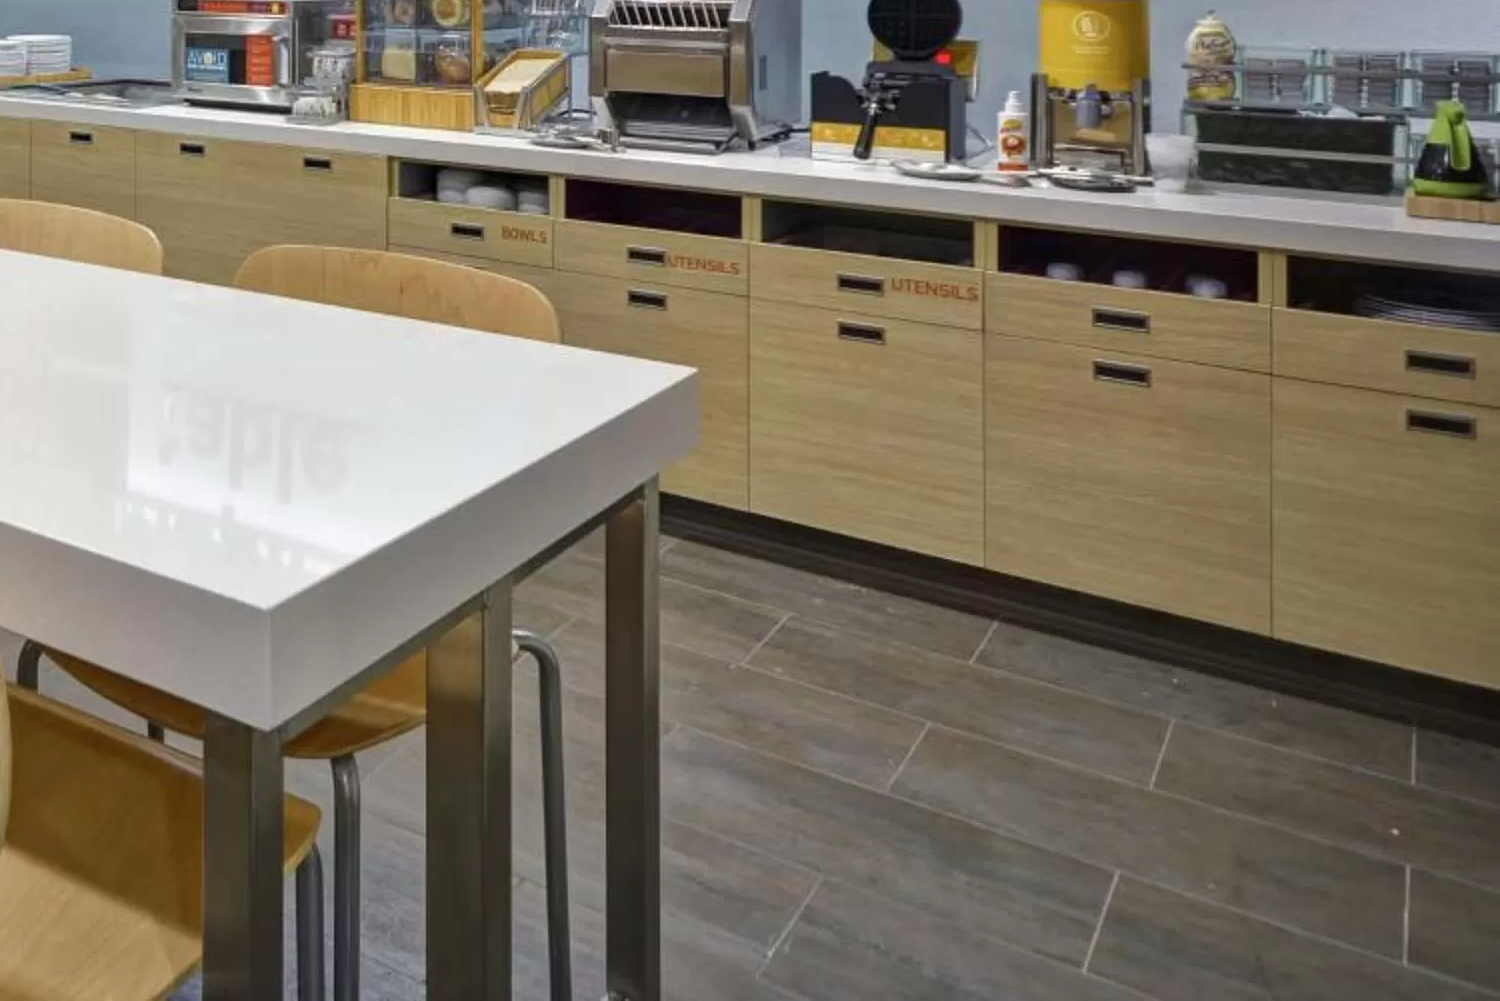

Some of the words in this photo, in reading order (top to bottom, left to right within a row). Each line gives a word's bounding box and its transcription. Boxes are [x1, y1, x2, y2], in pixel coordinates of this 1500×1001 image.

[501, 225, 549, 244] BOWLS
[667, 253, 740, 276] UTENSILS
[891, 277, 979, 302] UTENSILS
